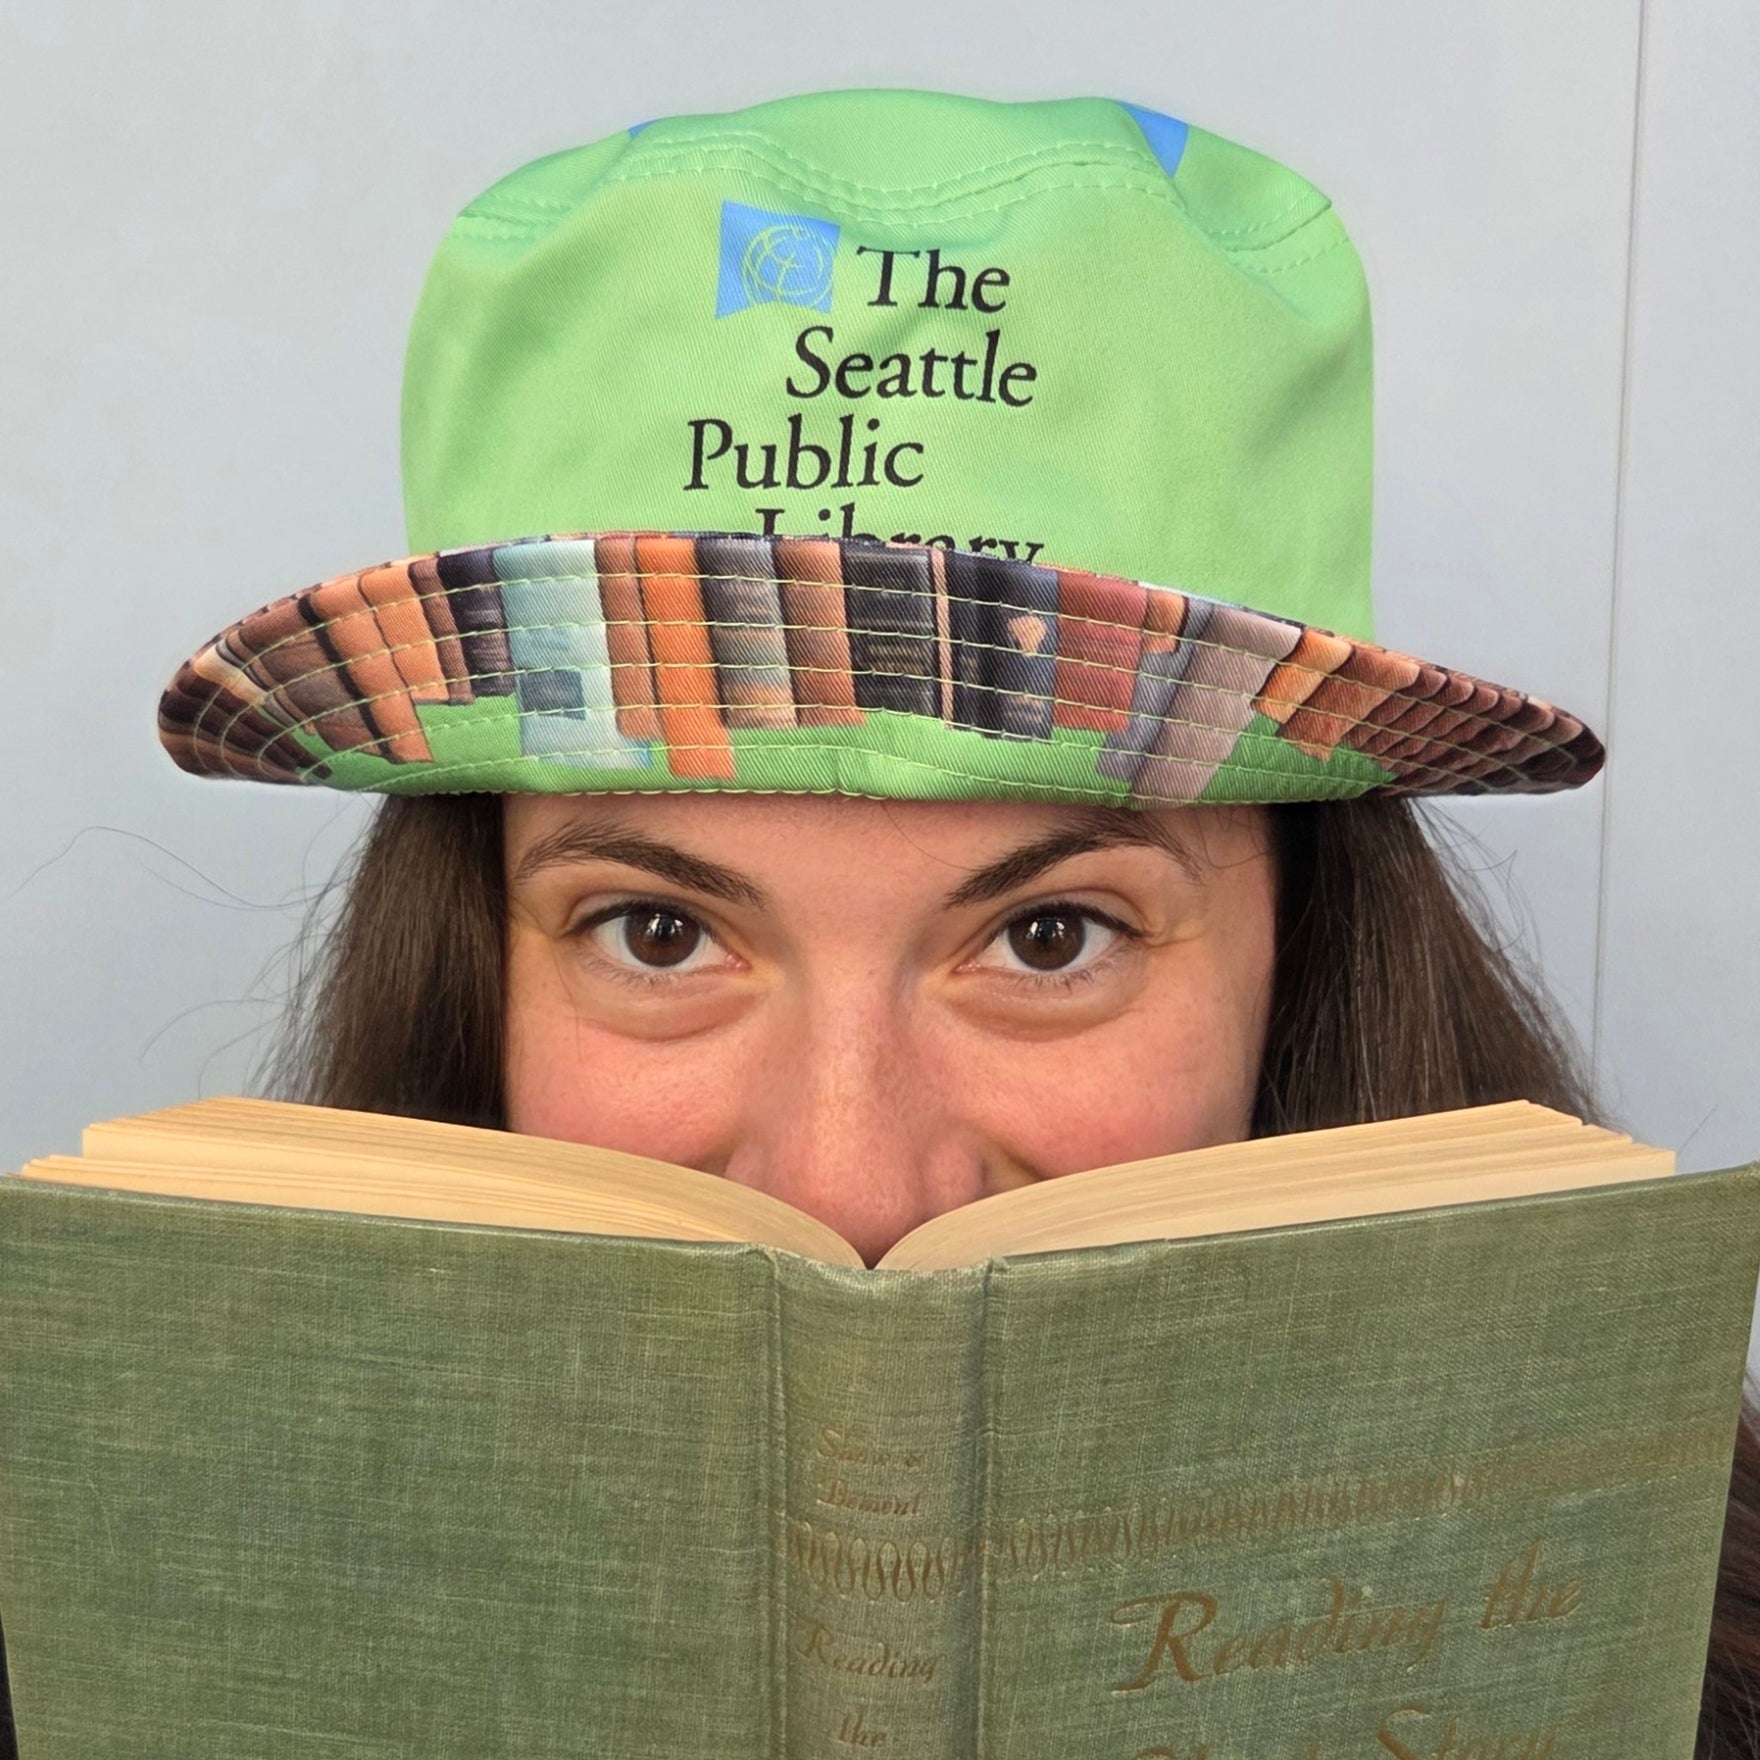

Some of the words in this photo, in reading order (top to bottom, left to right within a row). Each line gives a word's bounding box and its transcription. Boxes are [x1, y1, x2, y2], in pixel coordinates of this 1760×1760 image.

[856, 245, 1011, 314] The
[786, 325, 1038, 408] Seattle
[683, 413, 925, 491] Public
[795, 1614, 936, 1684] Reading
[1110, 1574, 1445, 1694] Reading
[1478, 1538, 1586, 1630] the
[838, 1706, 887, 1749] the
